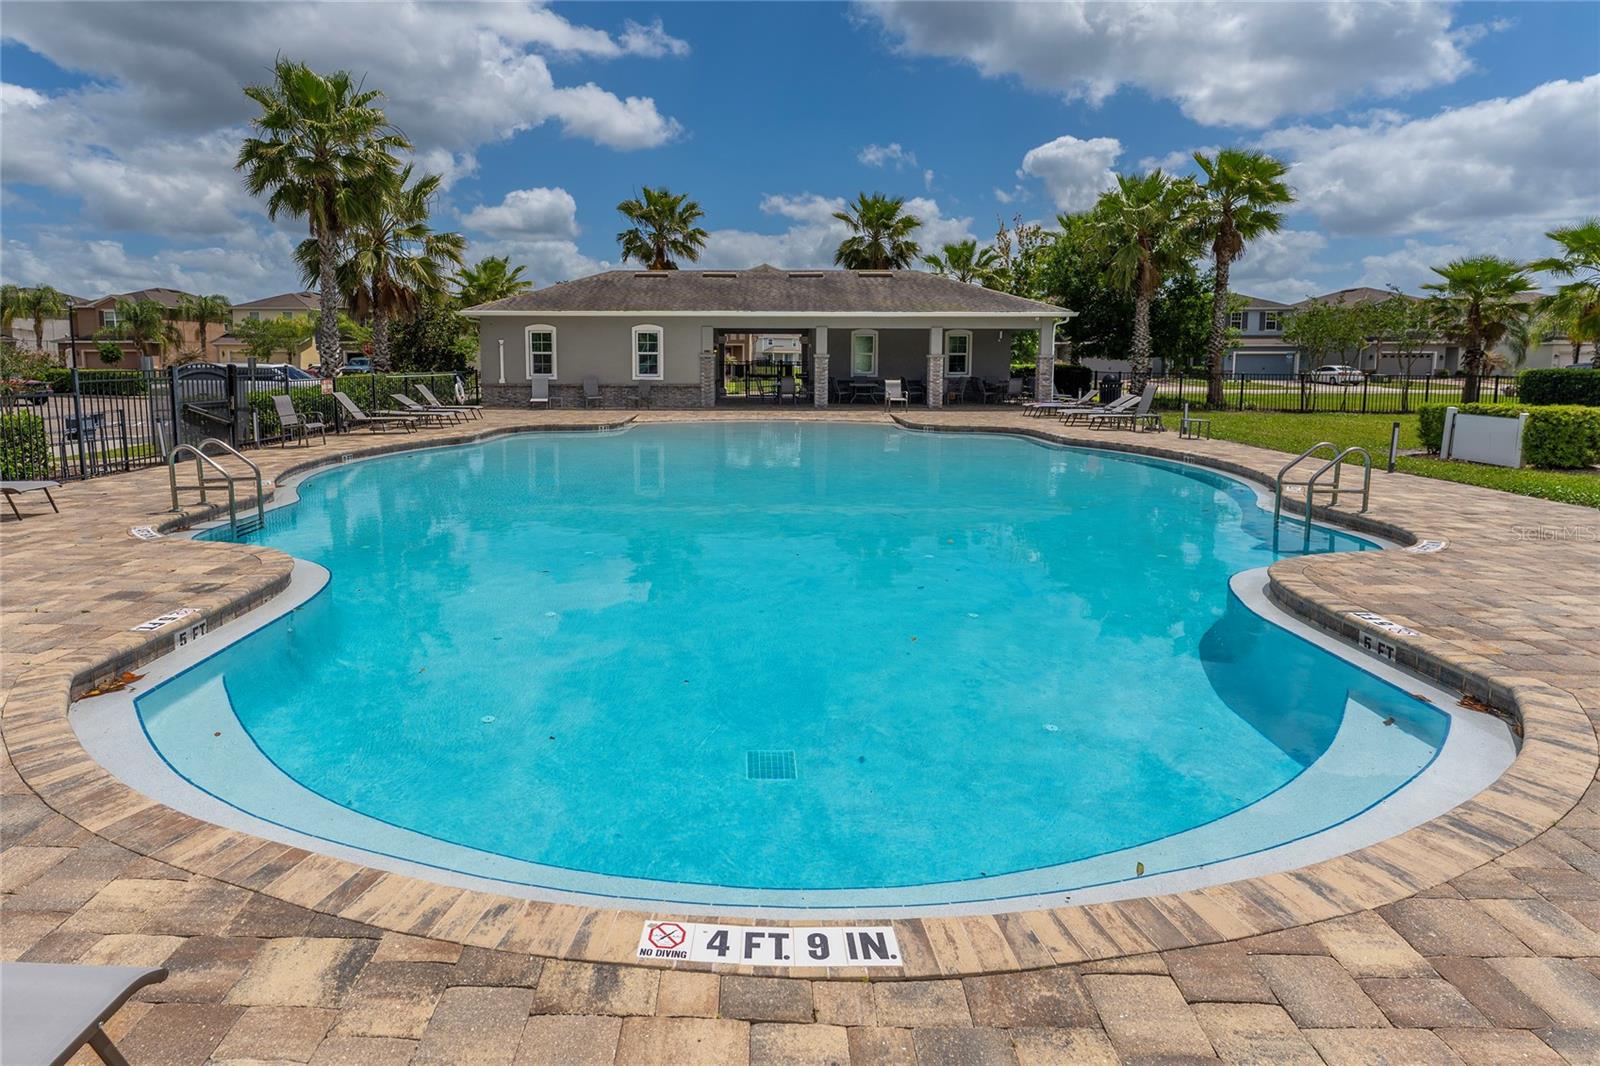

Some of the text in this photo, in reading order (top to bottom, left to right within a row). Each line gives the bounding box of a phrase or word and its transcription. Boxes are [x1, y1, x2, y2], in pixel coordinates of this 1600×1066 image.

[179, 622, 206, 646] 5 FT
[1364, 635, 1394, 659] 5 FT
[640, 948, 687, 959] NO DIVING
[706, 930, 897, 960] 4 FT. 9 IN.
